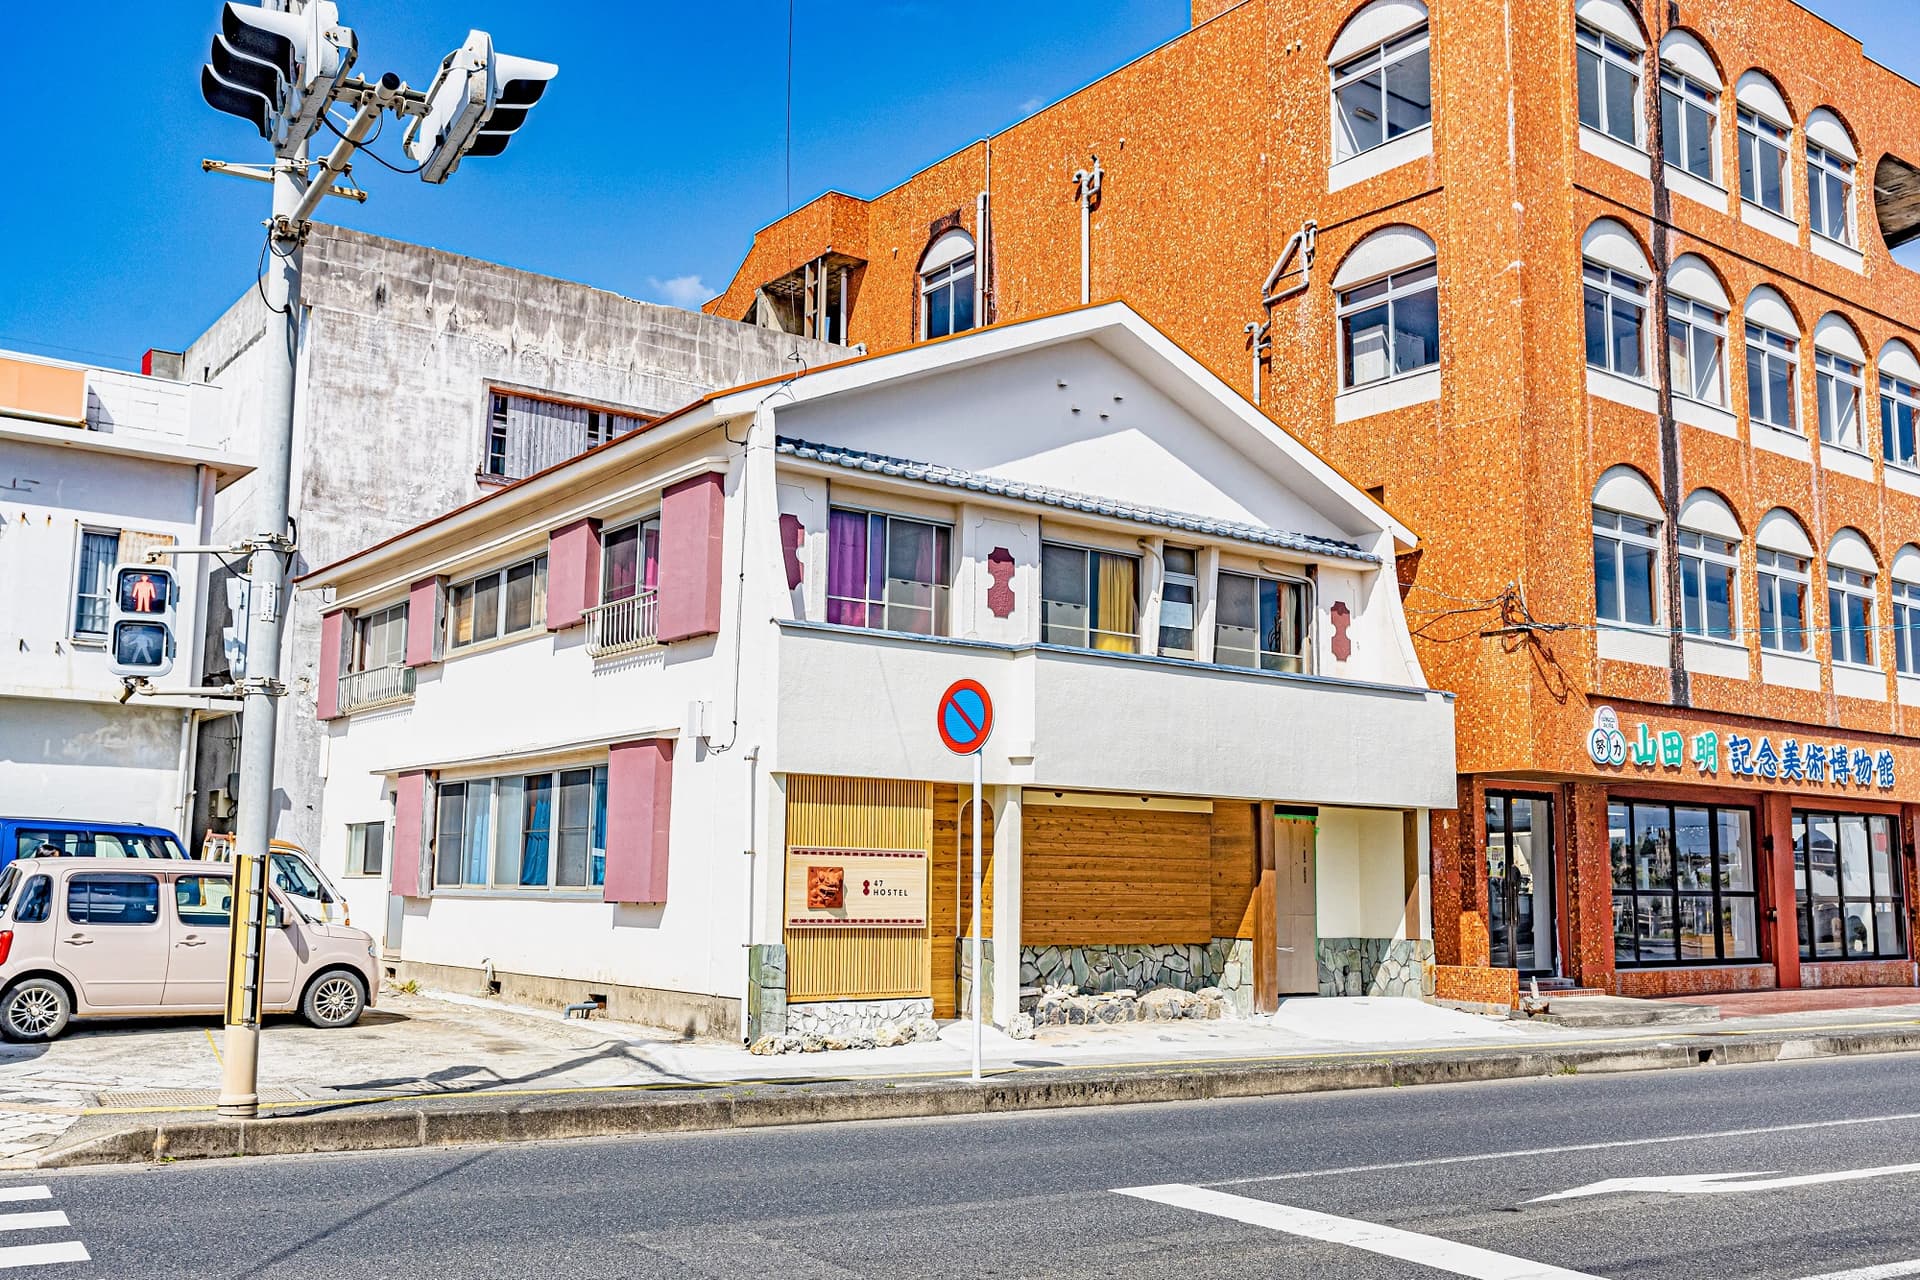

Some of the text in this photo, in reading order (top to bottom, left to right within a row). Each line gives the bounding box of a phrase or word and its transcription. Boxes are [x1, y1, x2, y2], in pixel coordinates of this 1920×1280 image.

[1728, 735, 1895, 786] 記念美術博物館
[873, 879, 884, 887] 47
[873, 888, 908, 897] HOSTEL
